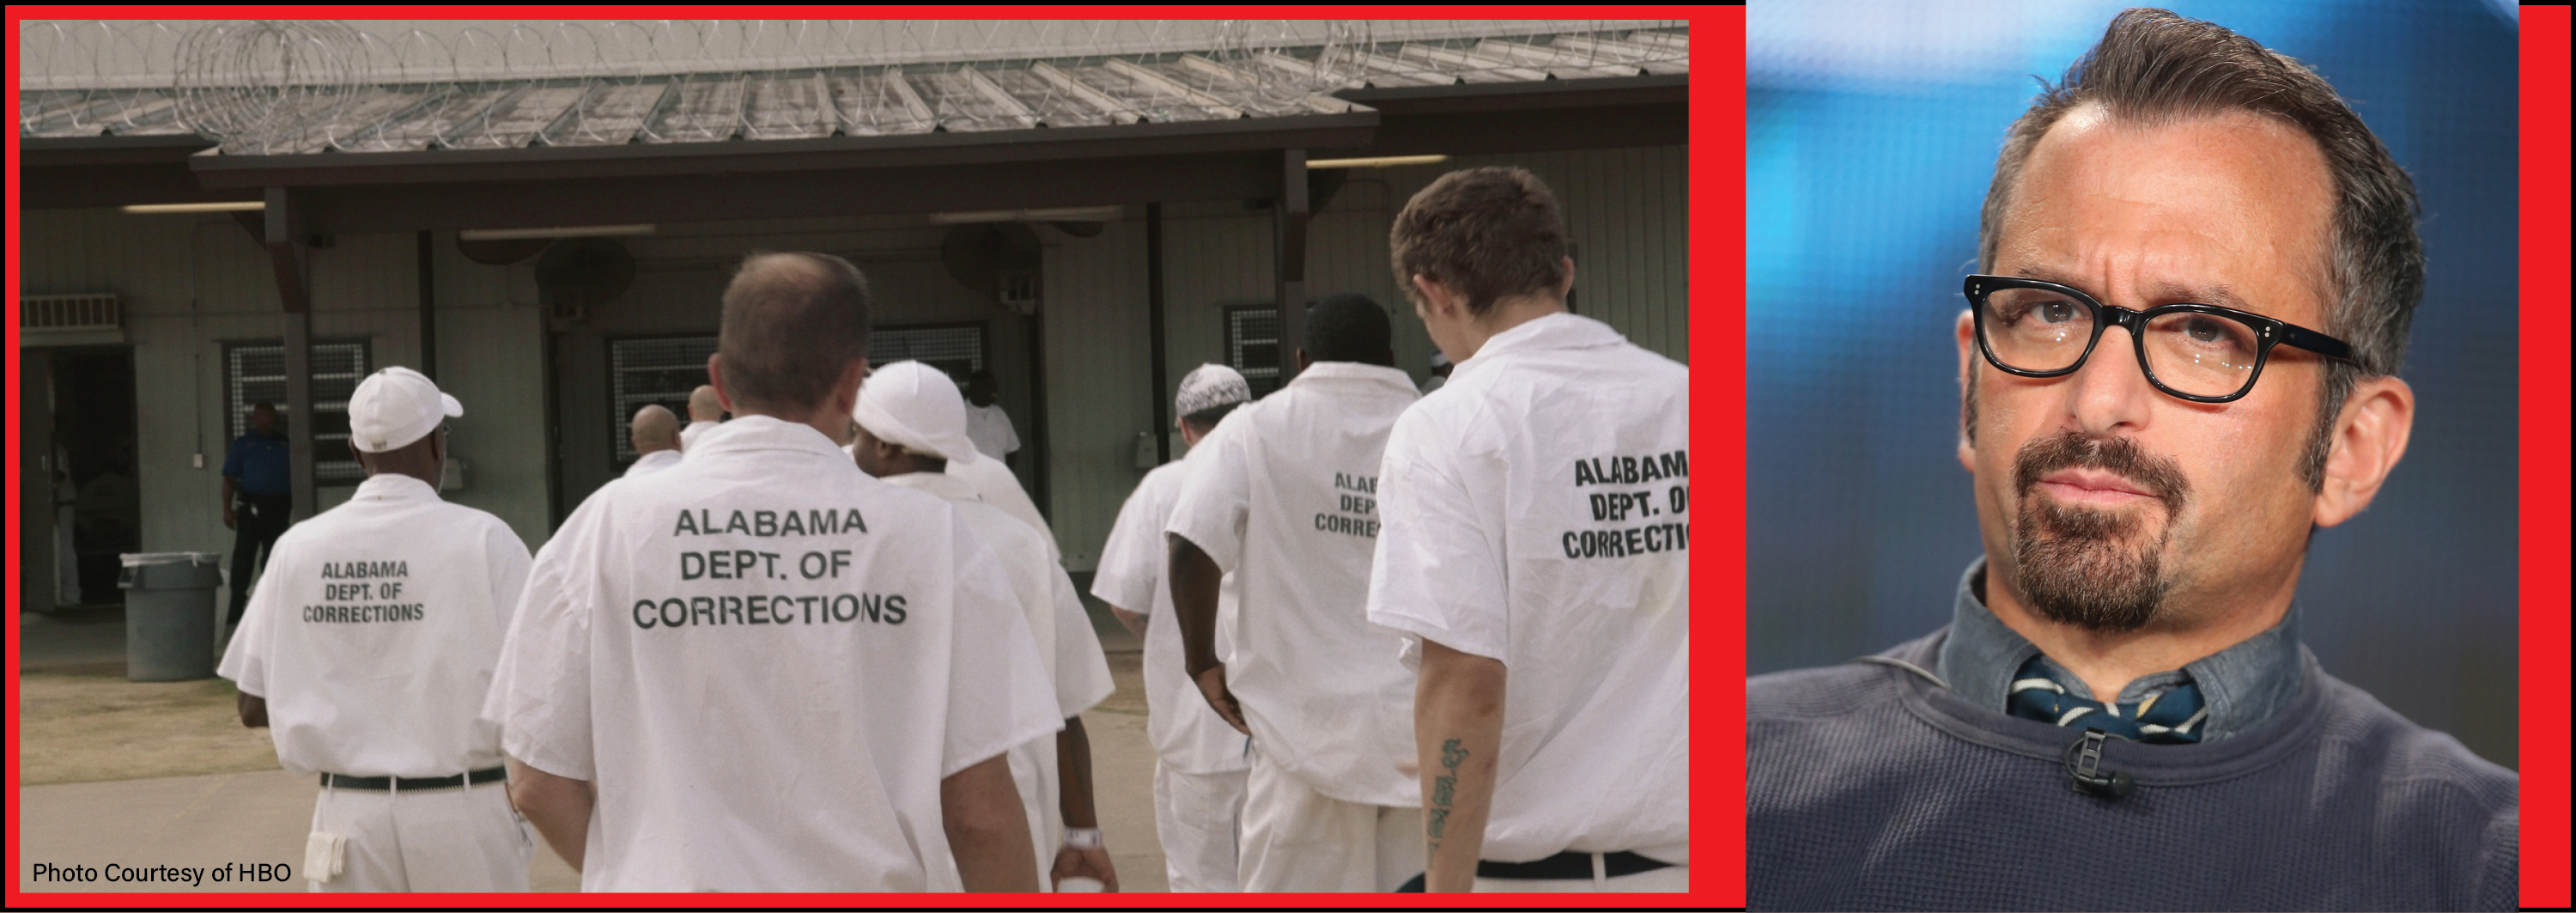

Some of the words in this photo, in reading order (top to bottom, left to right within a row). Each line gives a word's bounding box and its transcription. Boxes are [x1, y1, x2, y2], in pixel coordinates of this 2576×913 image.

[1575, 450, 1689, 487] ALABAM
[1589, 490, 1660, 521] DEPT.
[1669, 485, 1689, 514] O
[673, 508, 868, 537] ALABAMA
[1562, 522, 1689, 558] CORRECTI
[321, 561, 409, 579] ALABAMA
[681, 550, 787, 581] DEPT.
[799, 550, 852, 580] OF
[325, 584, 374, 600] DEPT.
[380, 582, 402, 600] OF
[303, 603, 424, 623] CORRECTIONS
[633, 593, 907, 629] CORRECTIONS
